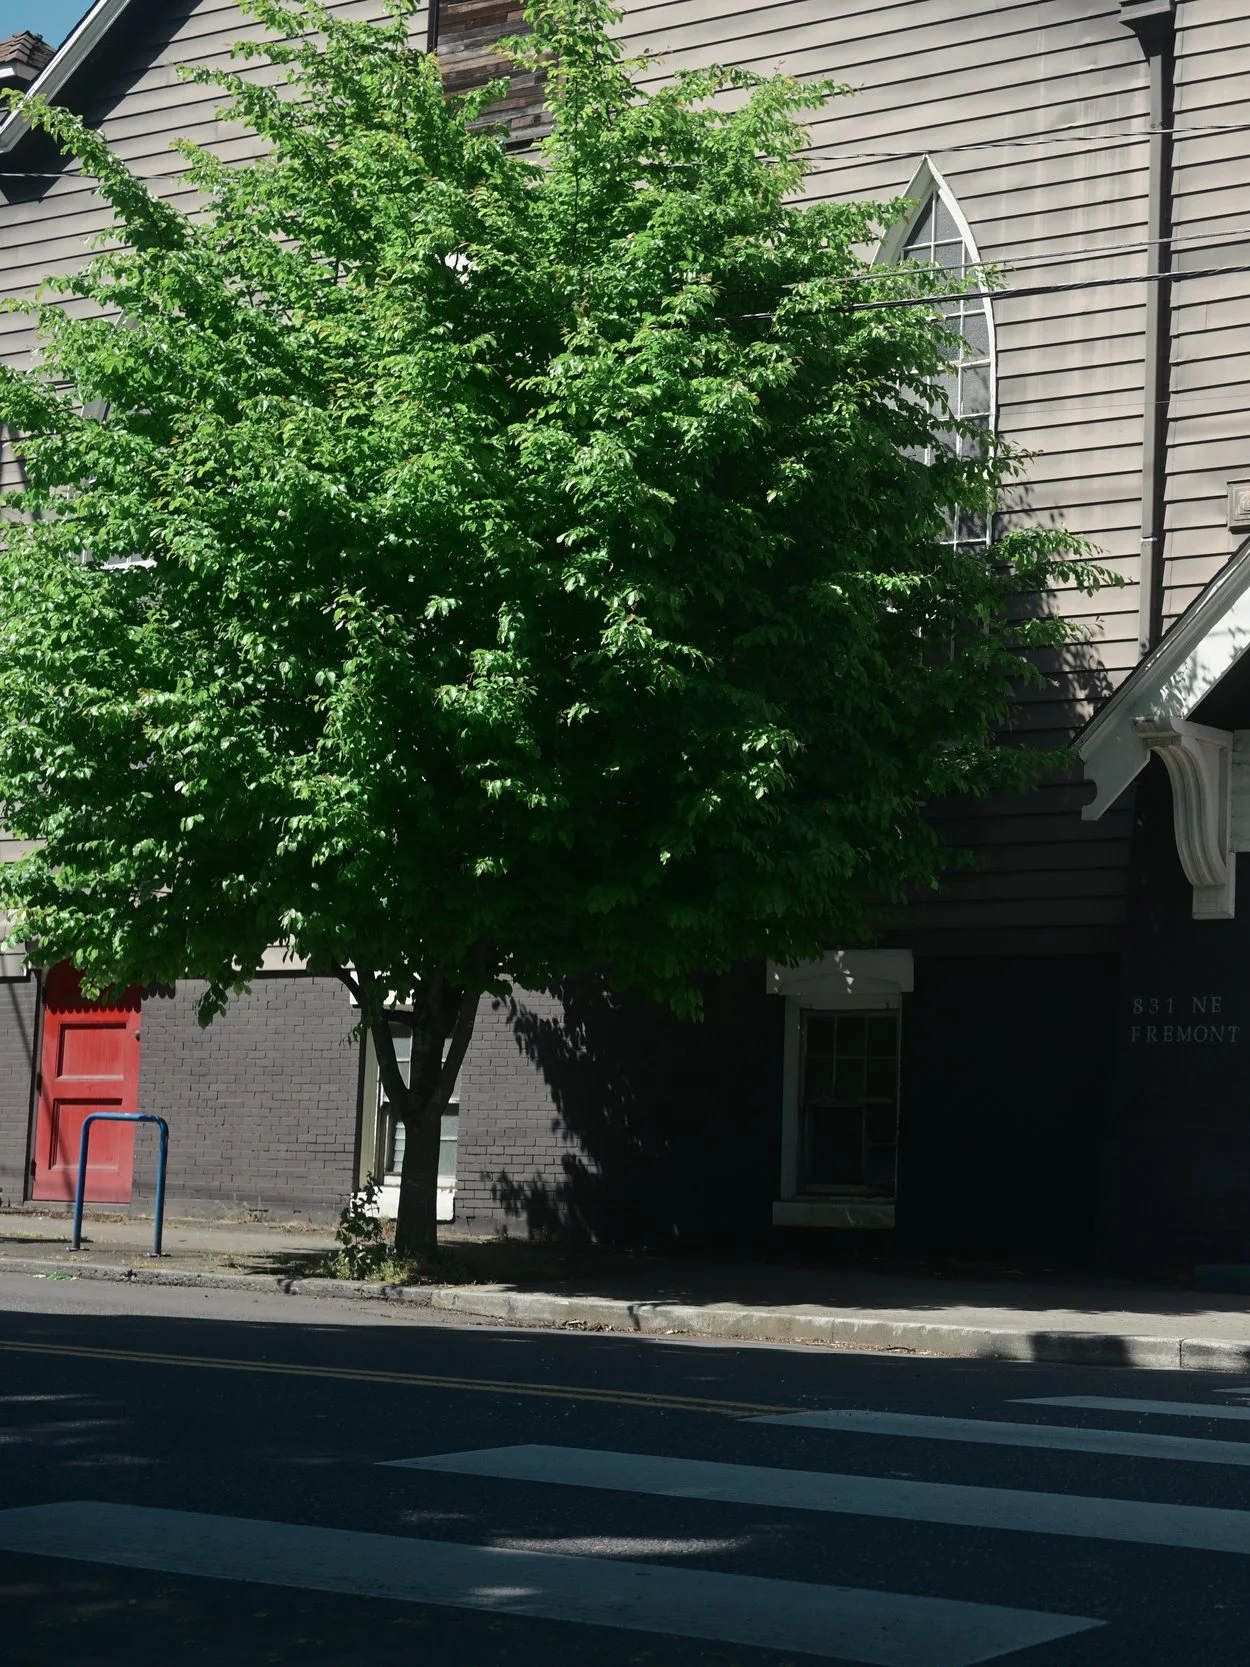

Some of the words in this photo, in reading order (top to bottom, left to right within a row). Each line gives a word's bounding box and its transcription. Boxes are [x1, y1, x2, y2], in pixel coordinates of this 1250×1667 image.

[1133, 998, 1173, 1015] 831
[1191, 996, 1222, 1013] NE
[1130, 1025, 1240, 1043] FREMONT
